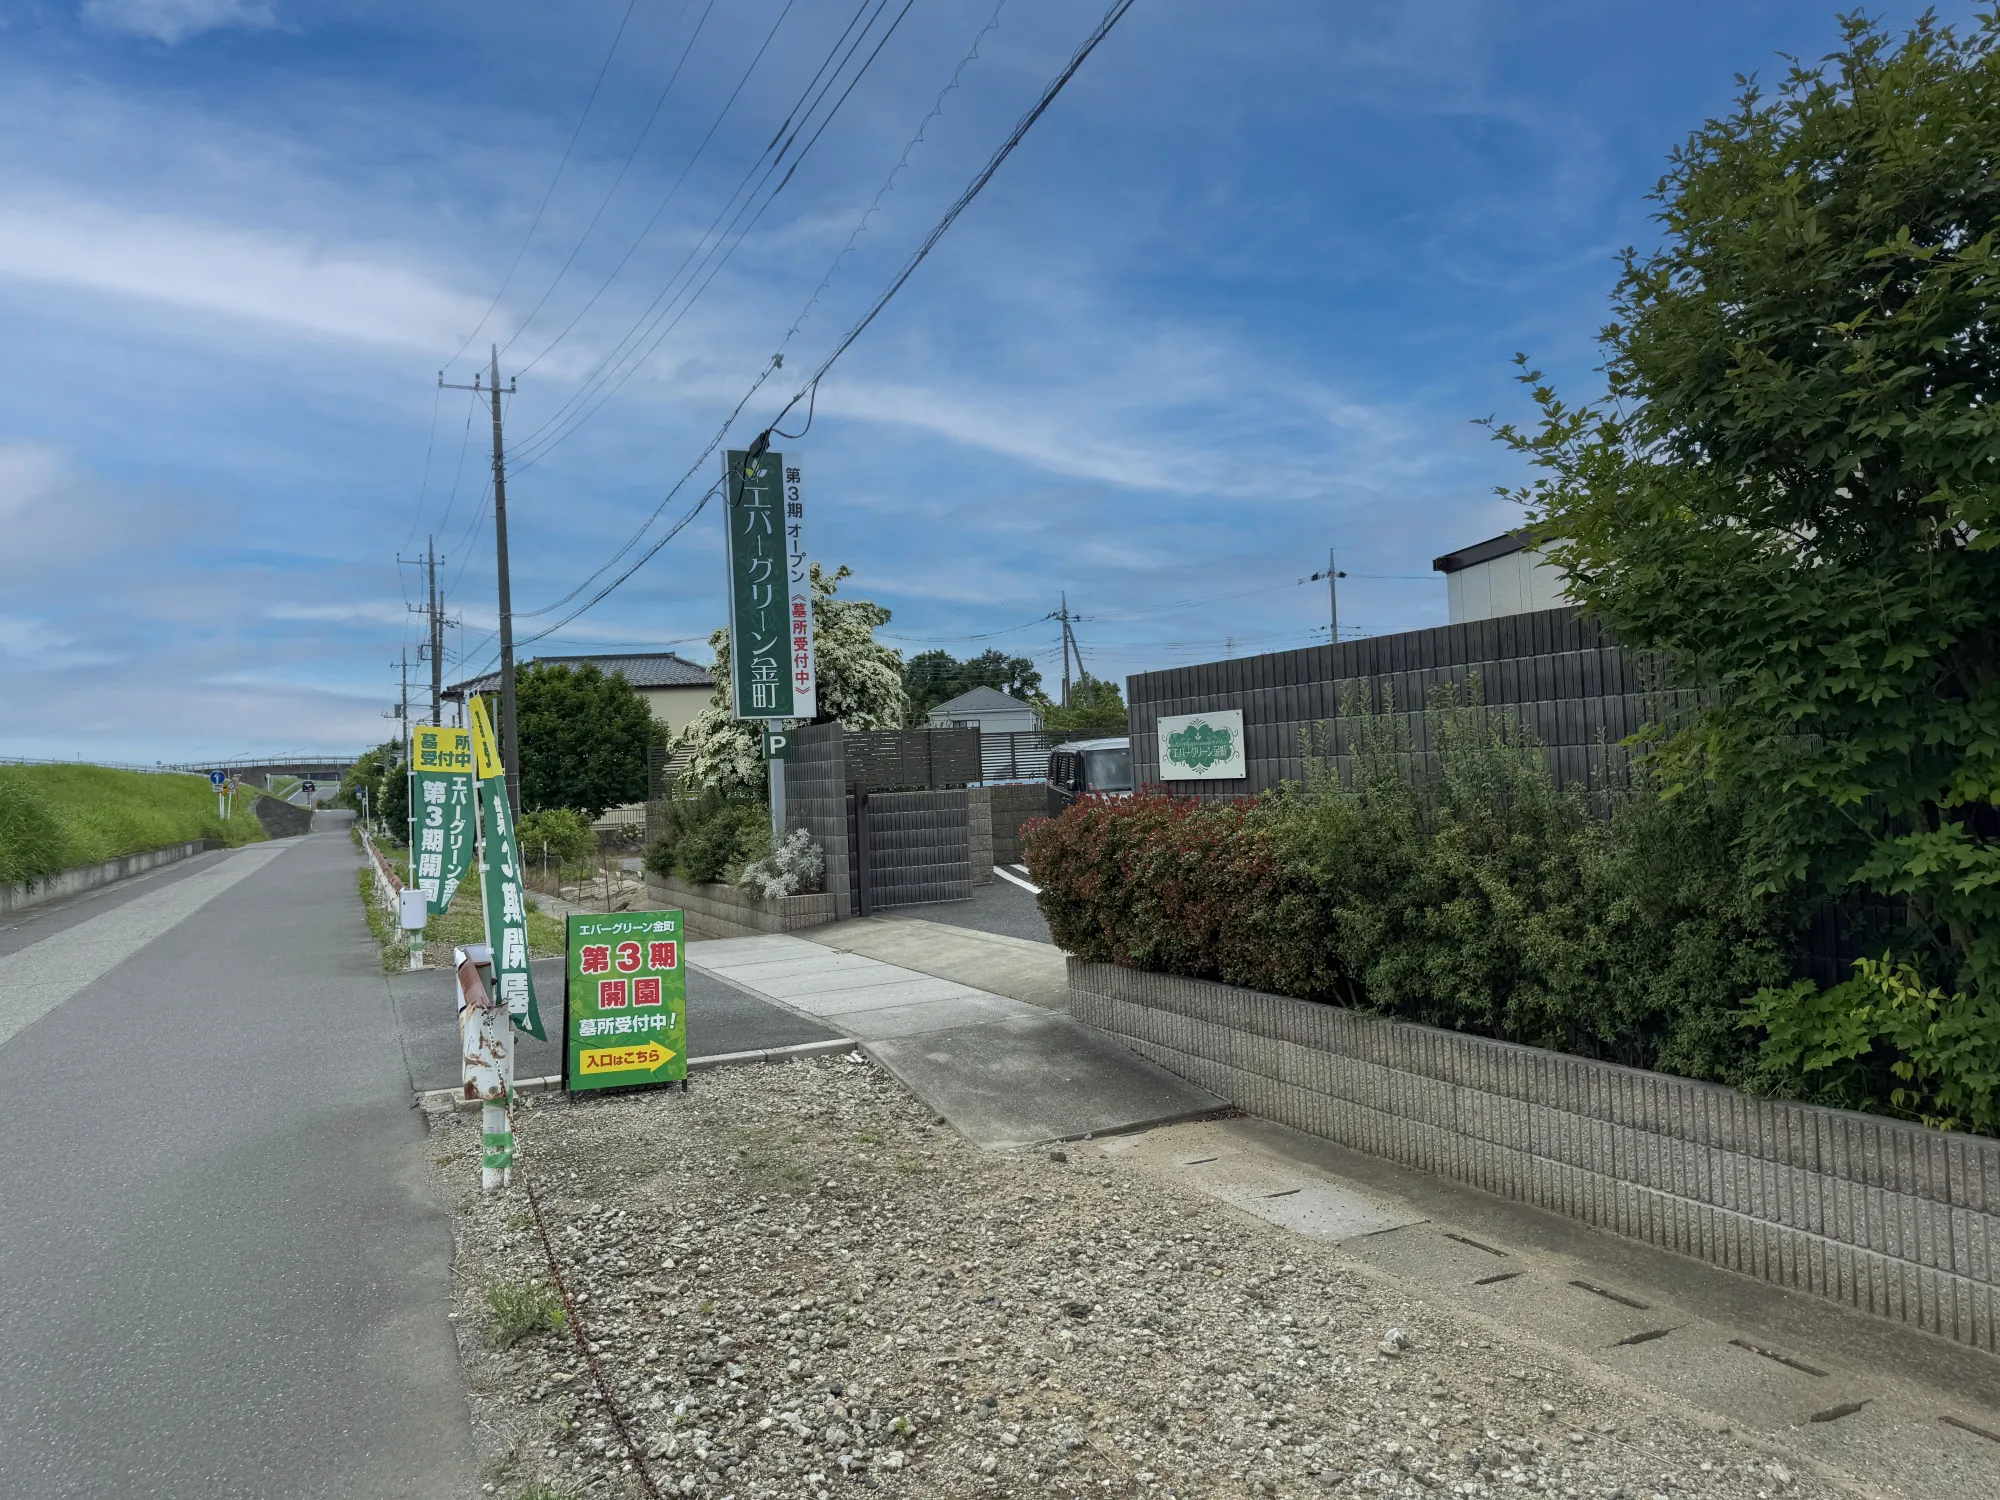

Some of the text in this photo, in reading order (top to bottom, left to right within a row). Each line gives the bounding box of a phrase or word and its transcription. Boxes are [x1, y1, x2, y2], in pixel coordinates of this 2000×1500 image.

[743, 486, 779, 709] エバーグリーン金町
[769, 735, 787, 755] P
[420, 750, 471, 767] 受付中
[579, 920, 675, 936] エバーグリーン金町
[580, 940, 677, 975] 第3期
[598, 976, 663, 1010] 開園
[586, 1049, 661, 1069] 入口はこちら
